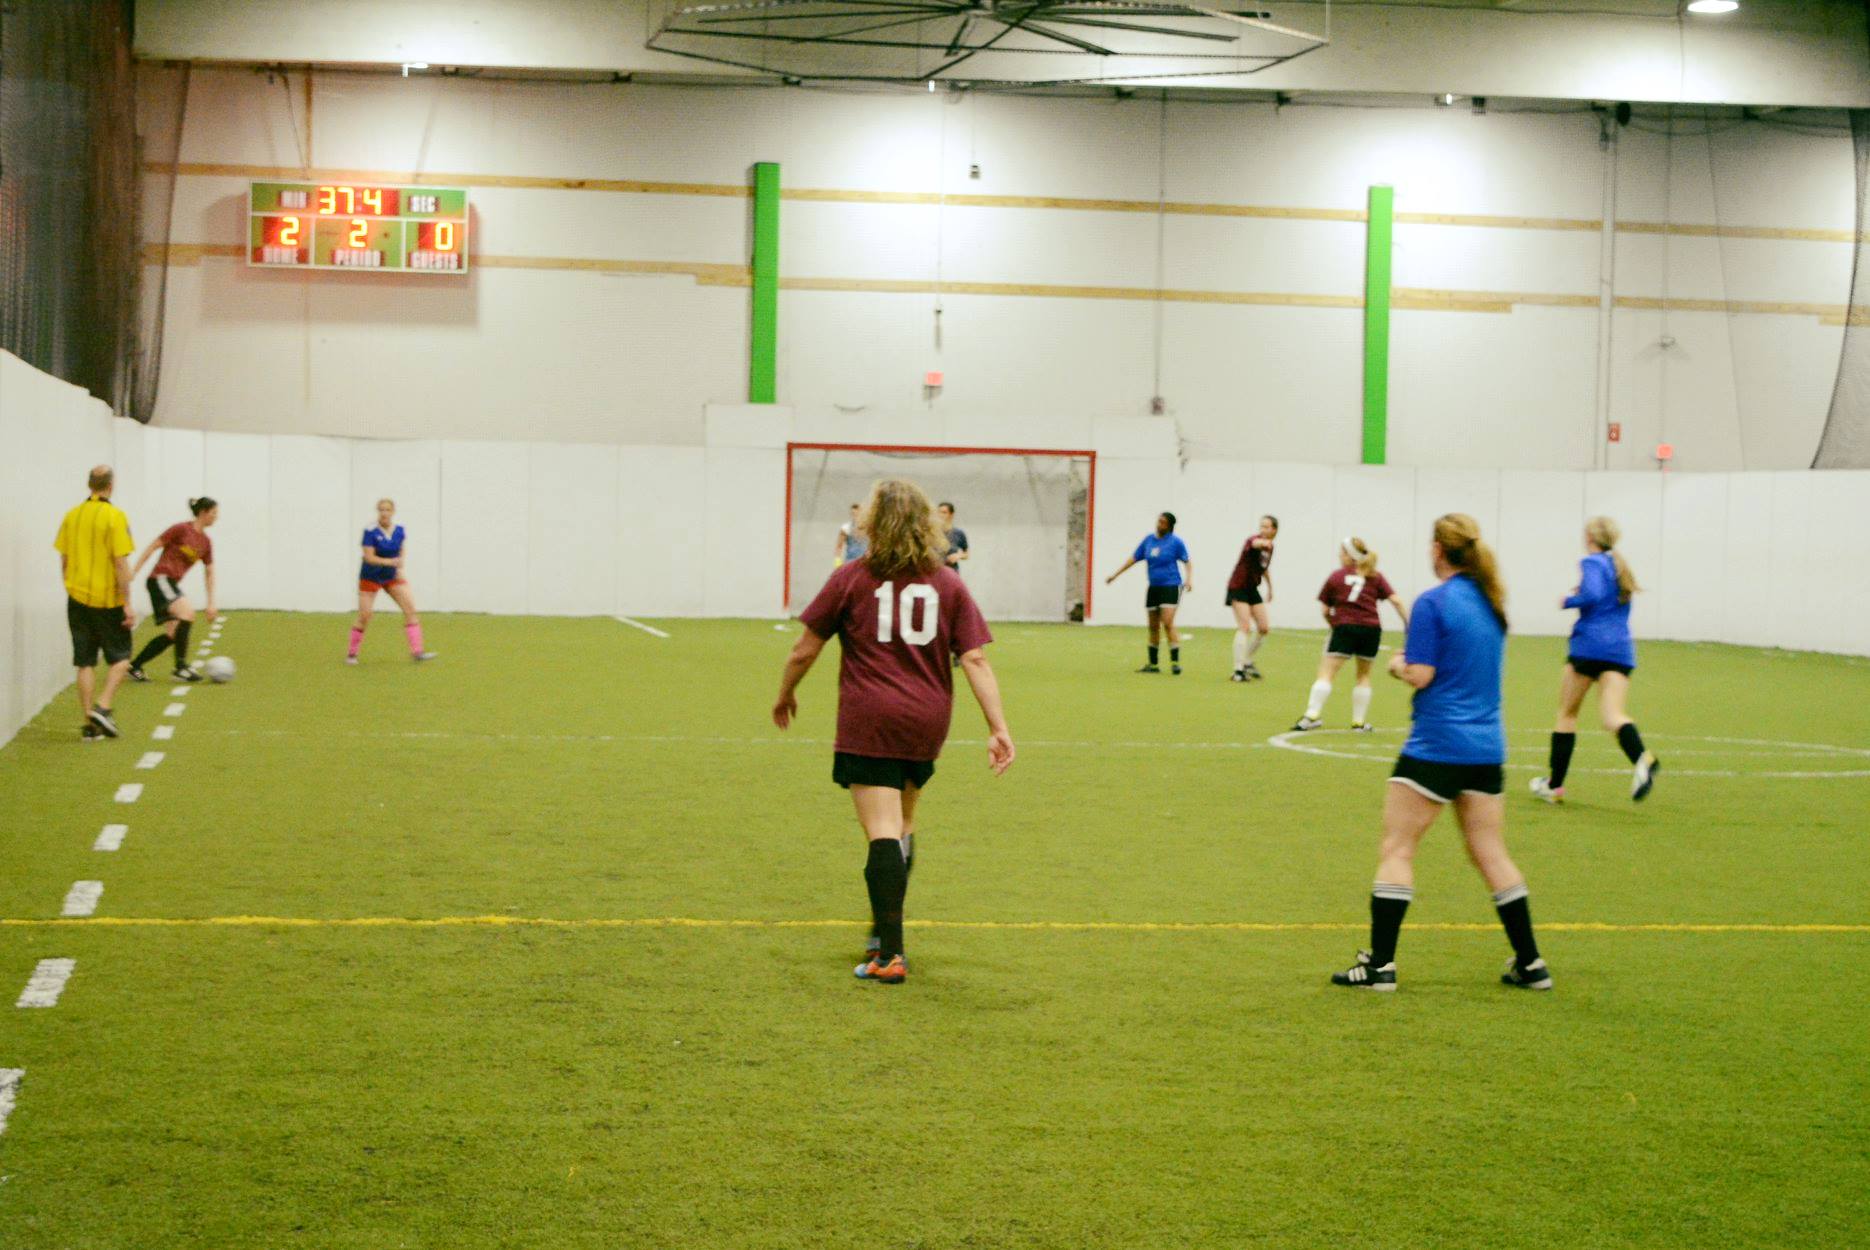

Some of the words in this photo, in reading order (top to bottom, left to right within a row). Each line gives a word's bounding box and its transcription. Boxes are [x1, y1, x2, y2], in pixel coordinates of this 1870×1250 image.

[280, 216, 299, 245] 2
[348, 219, 368, 247] 2
[435, 222, 454, 250] 0
[1344, 575, 1366, 602] 7
[874, 581, 939, 646] 10
